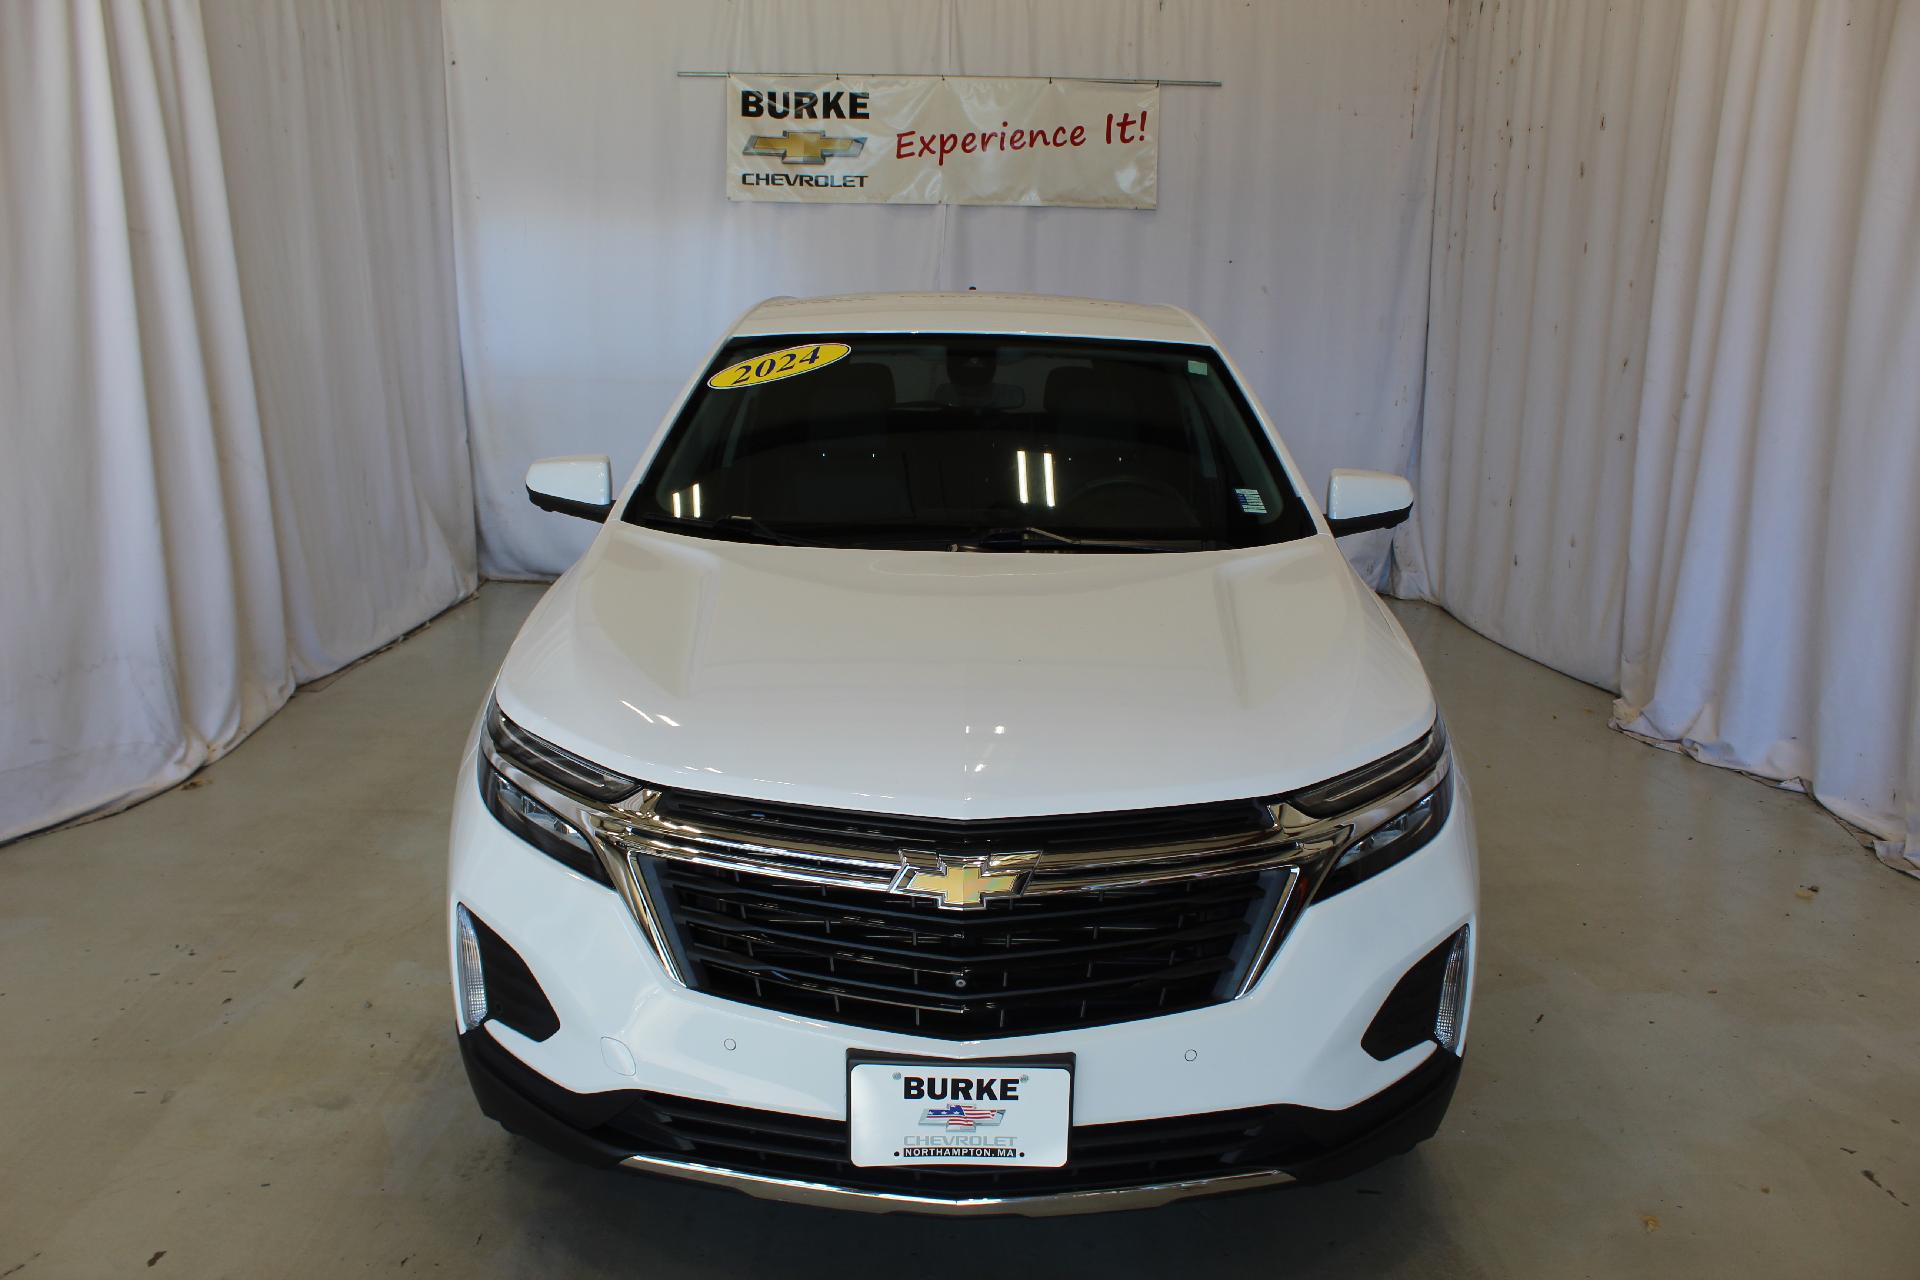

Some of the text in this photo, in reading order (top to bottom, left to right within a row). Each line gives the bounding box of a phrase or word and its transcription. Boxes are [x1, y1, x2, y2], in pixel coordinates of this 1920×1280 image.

[741, 90, 870, 119] BURKE
[896, 111, 1148, 166] Experience It!
[742, 173, 869, 188] CHEVROLET
[731, 346, 821, 385] 2024
[904, 1077, 1019, 1100] BURKE
[903, 1135, 1018, 1147] CHEVROLET
[997, 1148, 1015, 1157] MA
